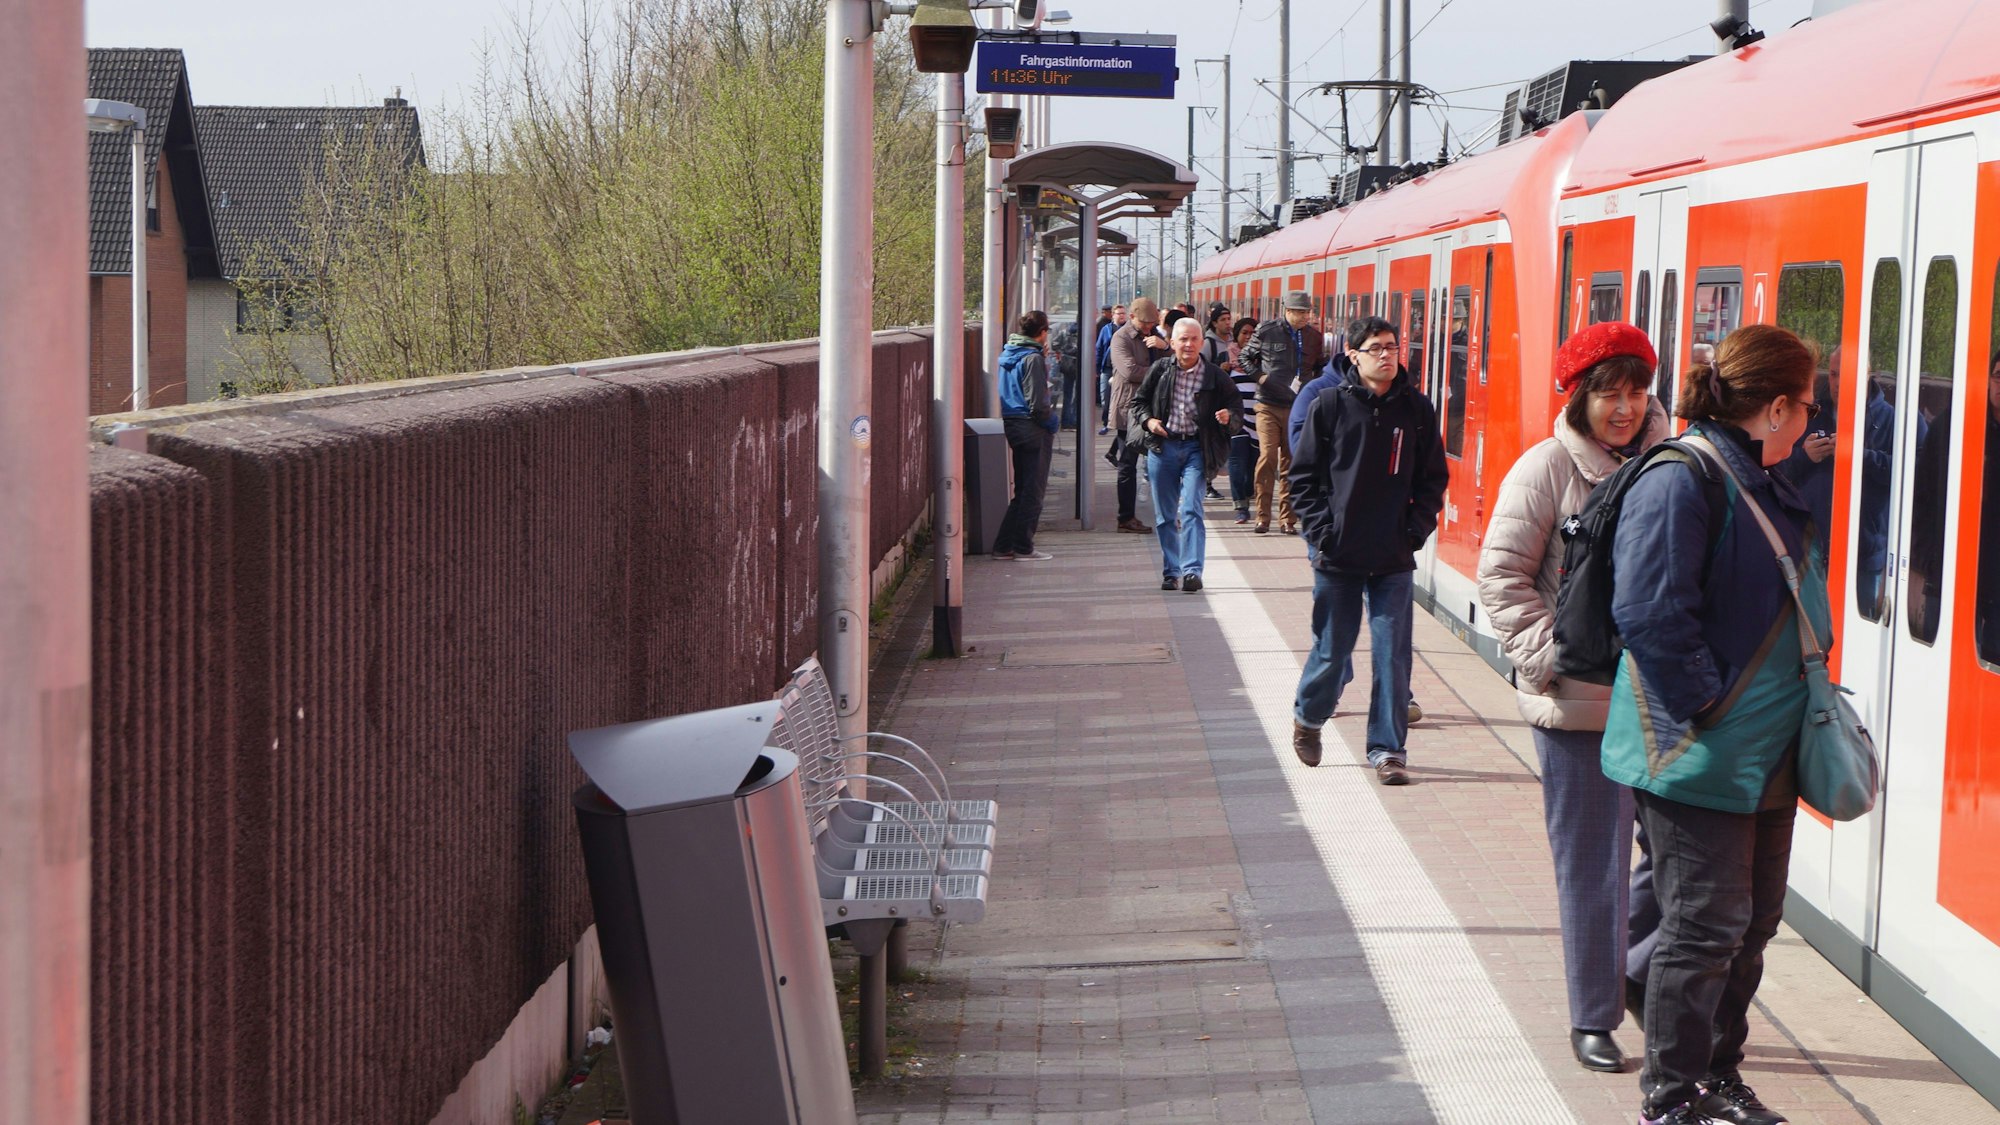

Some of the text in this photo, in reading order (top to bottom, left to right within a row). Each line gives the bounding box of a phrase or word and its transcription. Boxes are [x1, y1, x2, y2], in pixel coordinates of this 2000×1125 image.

[1020, 54, 1133, 69] Fahrgastinformation
[990, 69, 1073, 85] 11:36 Uhr
[1471, 295, 1480, 343] 2
